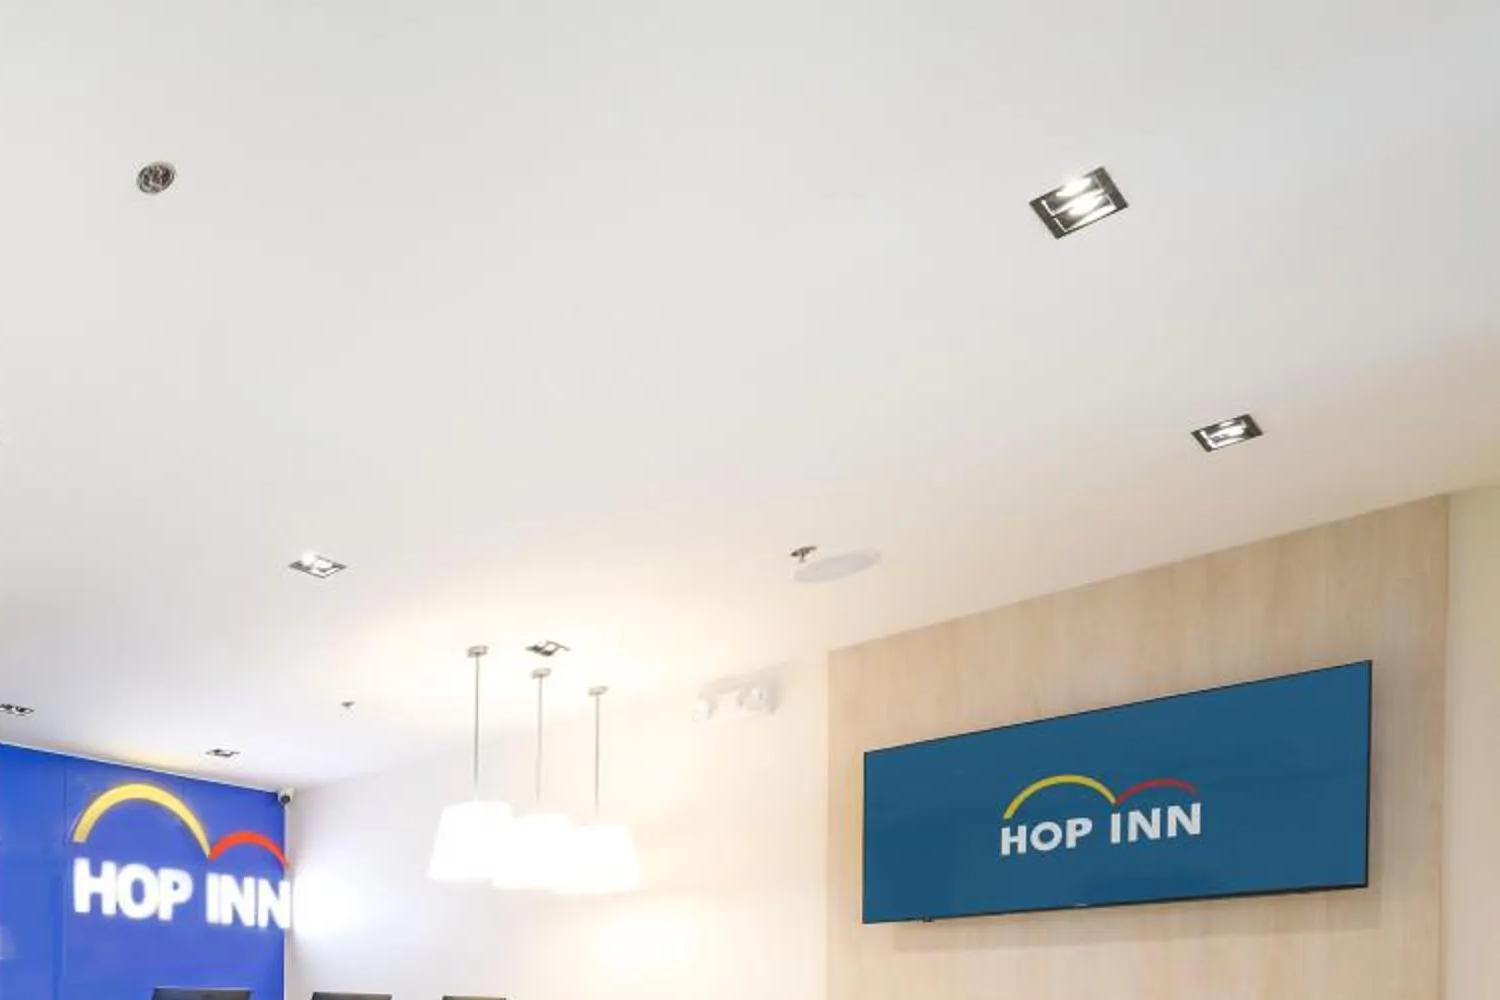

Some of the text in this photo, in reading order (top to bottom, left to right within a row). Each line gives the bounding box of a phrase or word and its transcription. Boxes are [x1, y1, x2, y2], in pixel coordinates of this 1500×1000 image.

[1001, 802, 1201, 856] HOP INN
[73, 858, 291, 928] HOP INN
